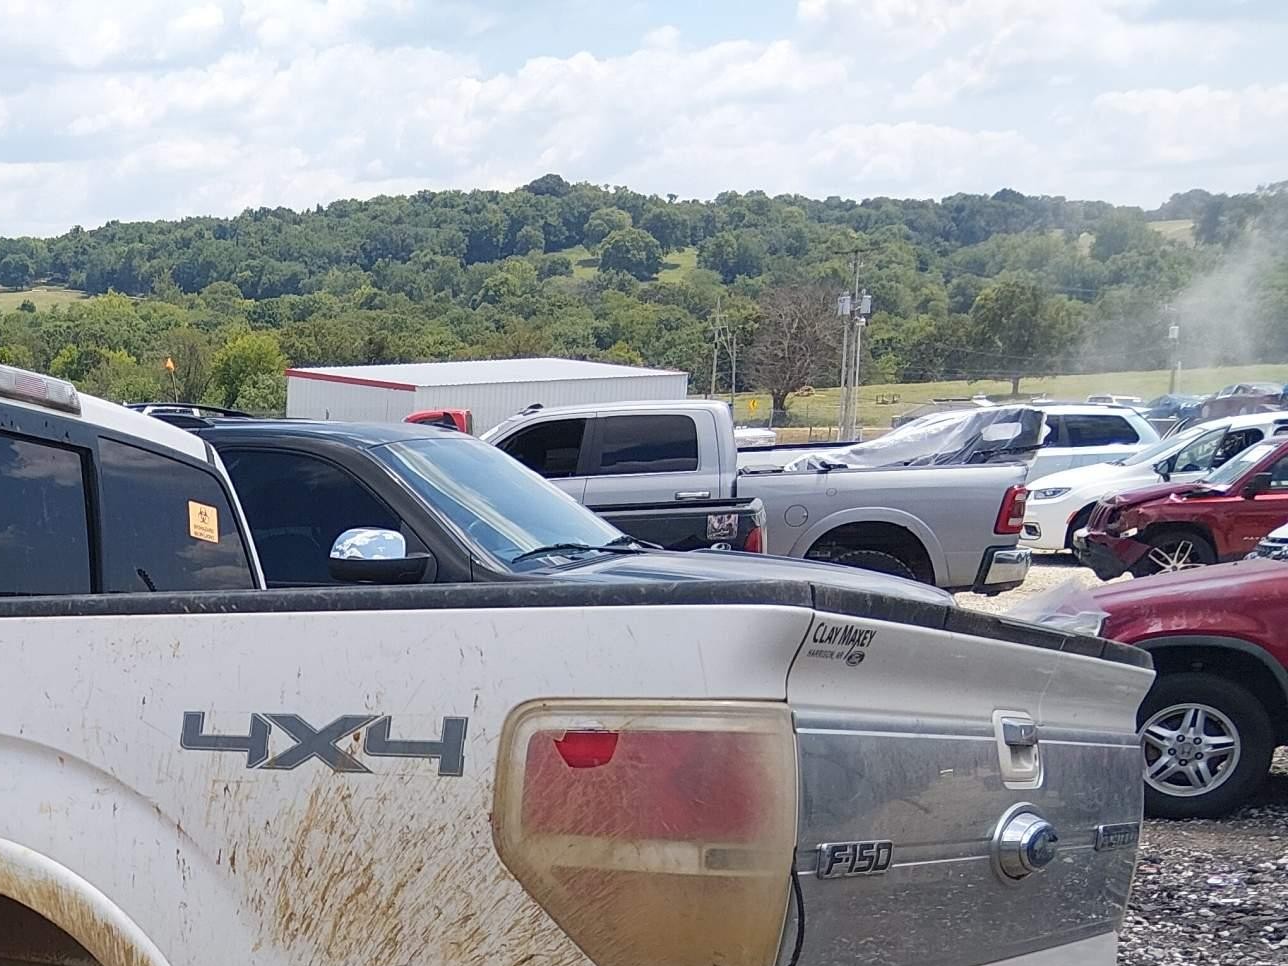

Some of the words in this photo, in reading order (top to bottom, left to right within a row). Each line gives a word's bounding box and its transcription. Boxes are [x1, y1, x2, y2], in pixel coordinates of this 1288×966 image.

[813, 622, 842, 645] CLAY
[838, 624, 877, 649] MAXEY
[824, 842, 892, 876] F-150
